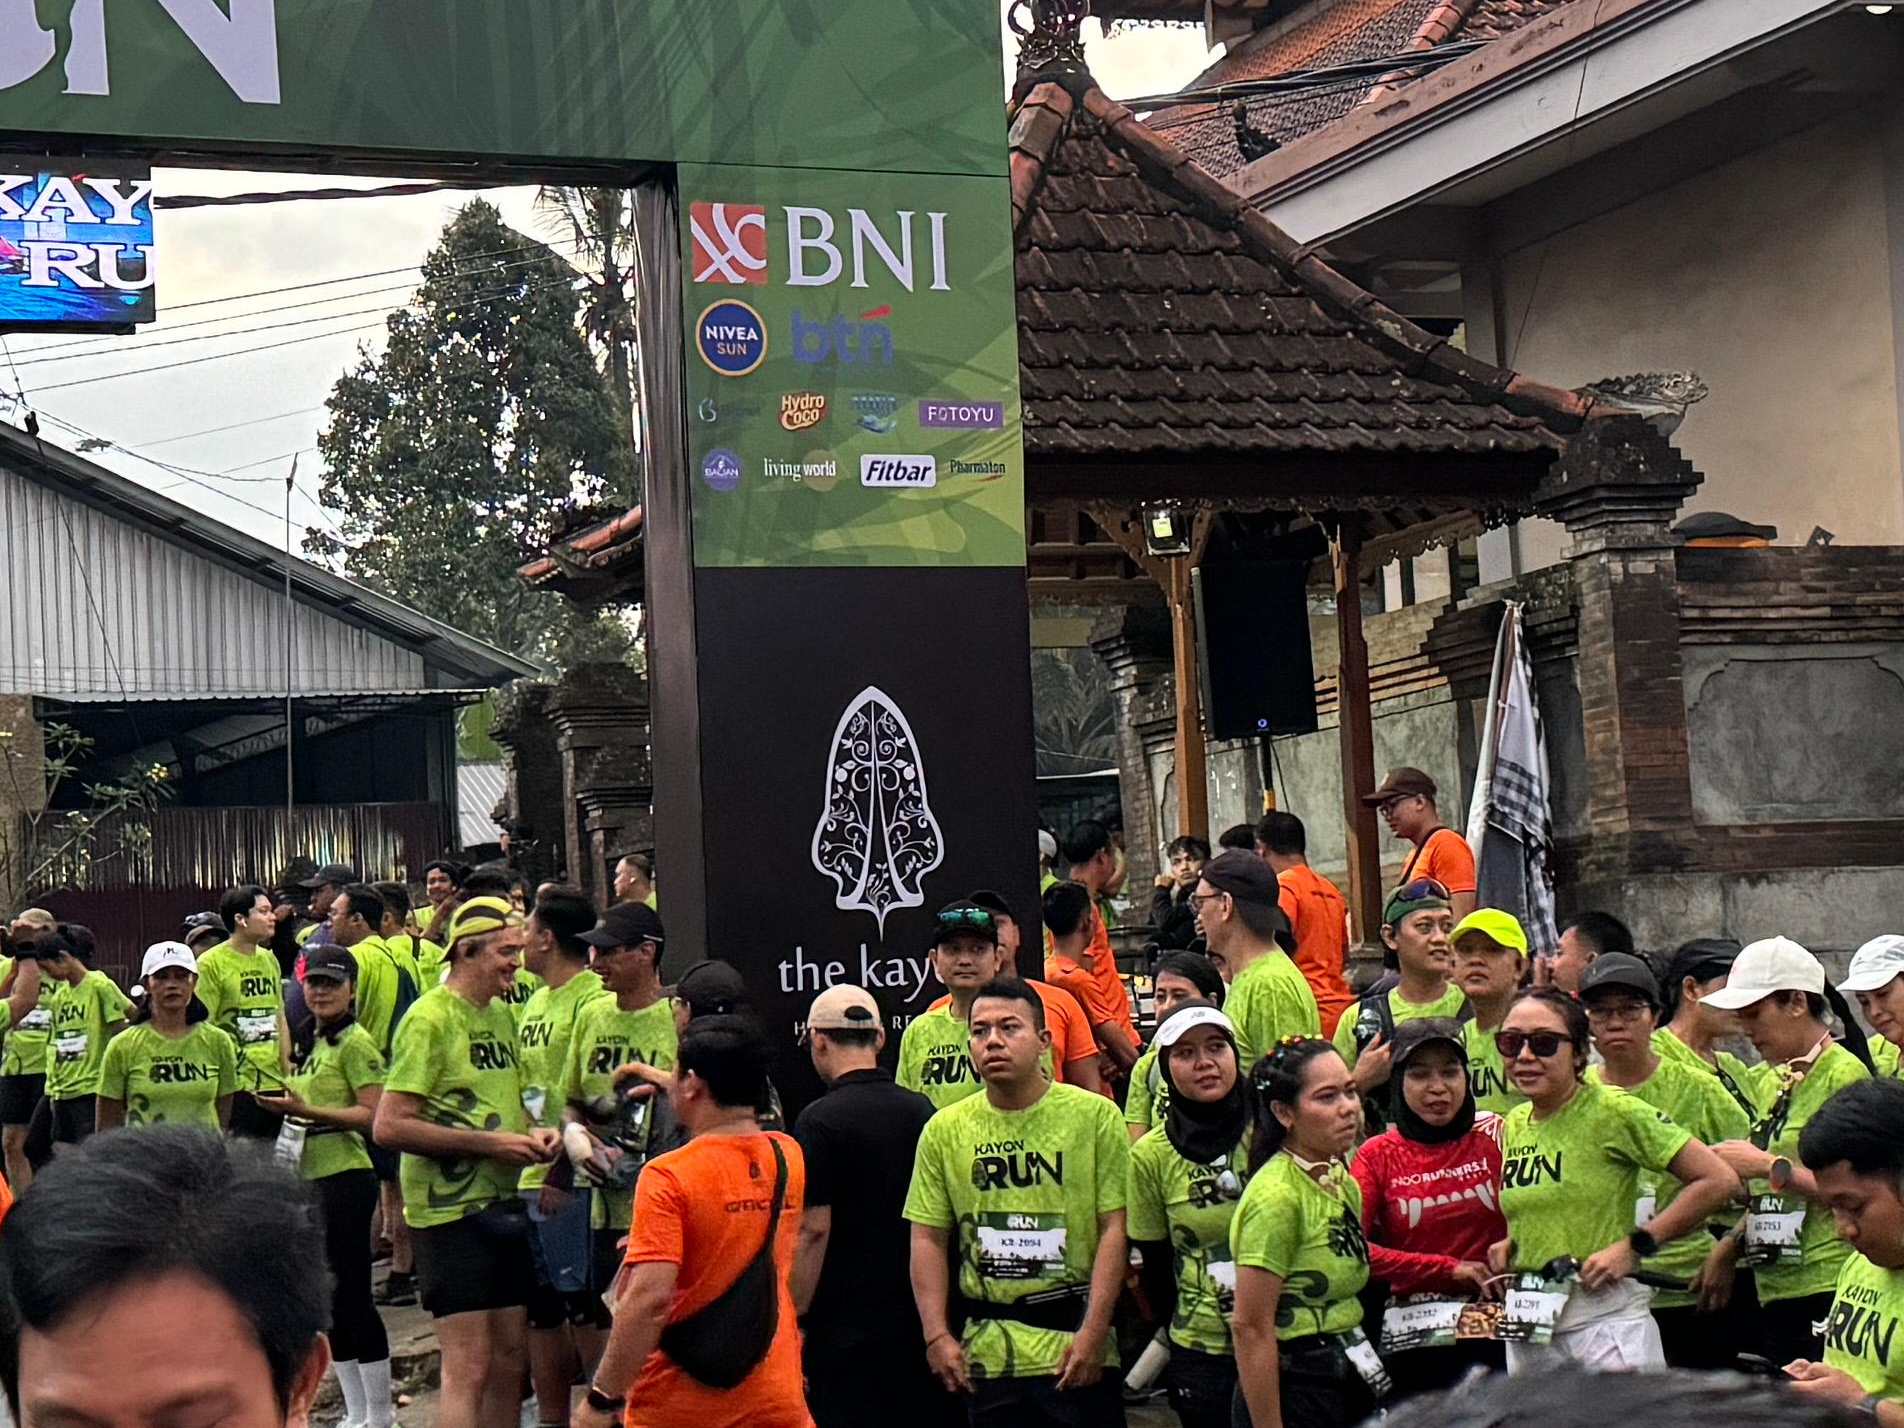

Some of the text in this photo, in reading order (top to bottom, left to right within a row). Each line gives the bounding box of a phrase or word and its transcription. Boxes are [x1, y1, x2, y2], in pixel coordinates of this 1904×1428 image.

[782, 205, 952, 292] BNI
[705, 325, 758, 341] NIVEA
[790, 305, 894, 365] btn
[716, 341, 747, 356] SUN
[781, 393, 826, 413] Hydro
[927, 406, 994, 422] FOTOYU
[781, 408, 820, 430] Coco
[763, 458, 837, 481] living world
[865, 460, 932, 482] Fitbar
[779, 942, 943, 1003] the kay
[973, 1139, 1025, 1156] KAYON
[971, 1151, 1064, 1192] RUN
[1500, 1151, 1563, 1190] RUN
